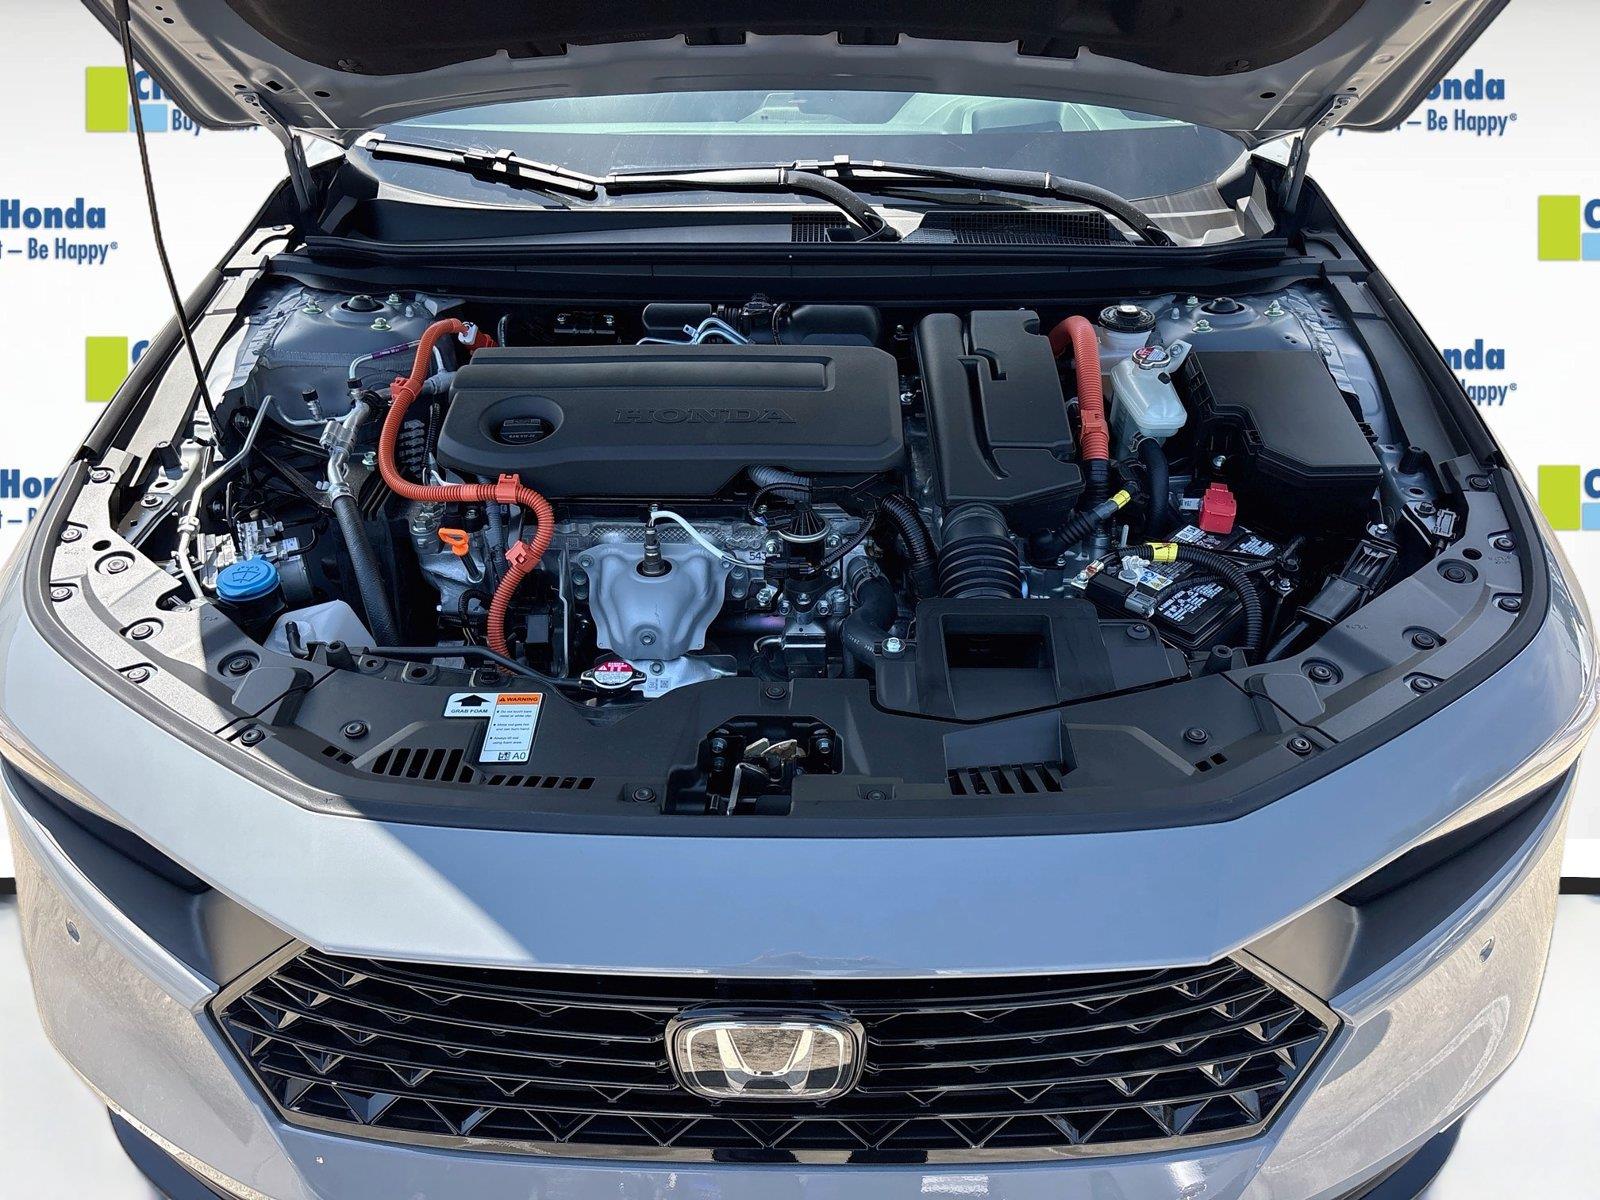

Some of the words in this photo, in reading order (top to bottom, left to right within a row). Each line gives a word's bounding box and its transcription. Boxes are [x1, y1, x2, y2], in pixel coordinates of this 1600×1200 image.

[1426, 69, 1505, 100] onda
[1427, 109, 1448, 132] Be
[0, 198, 106, 229] Honda
[28, 237, 49, 260] Be
[1443, 339, 1505, 370] nda
[612, 408, 797, 425] HONDA
